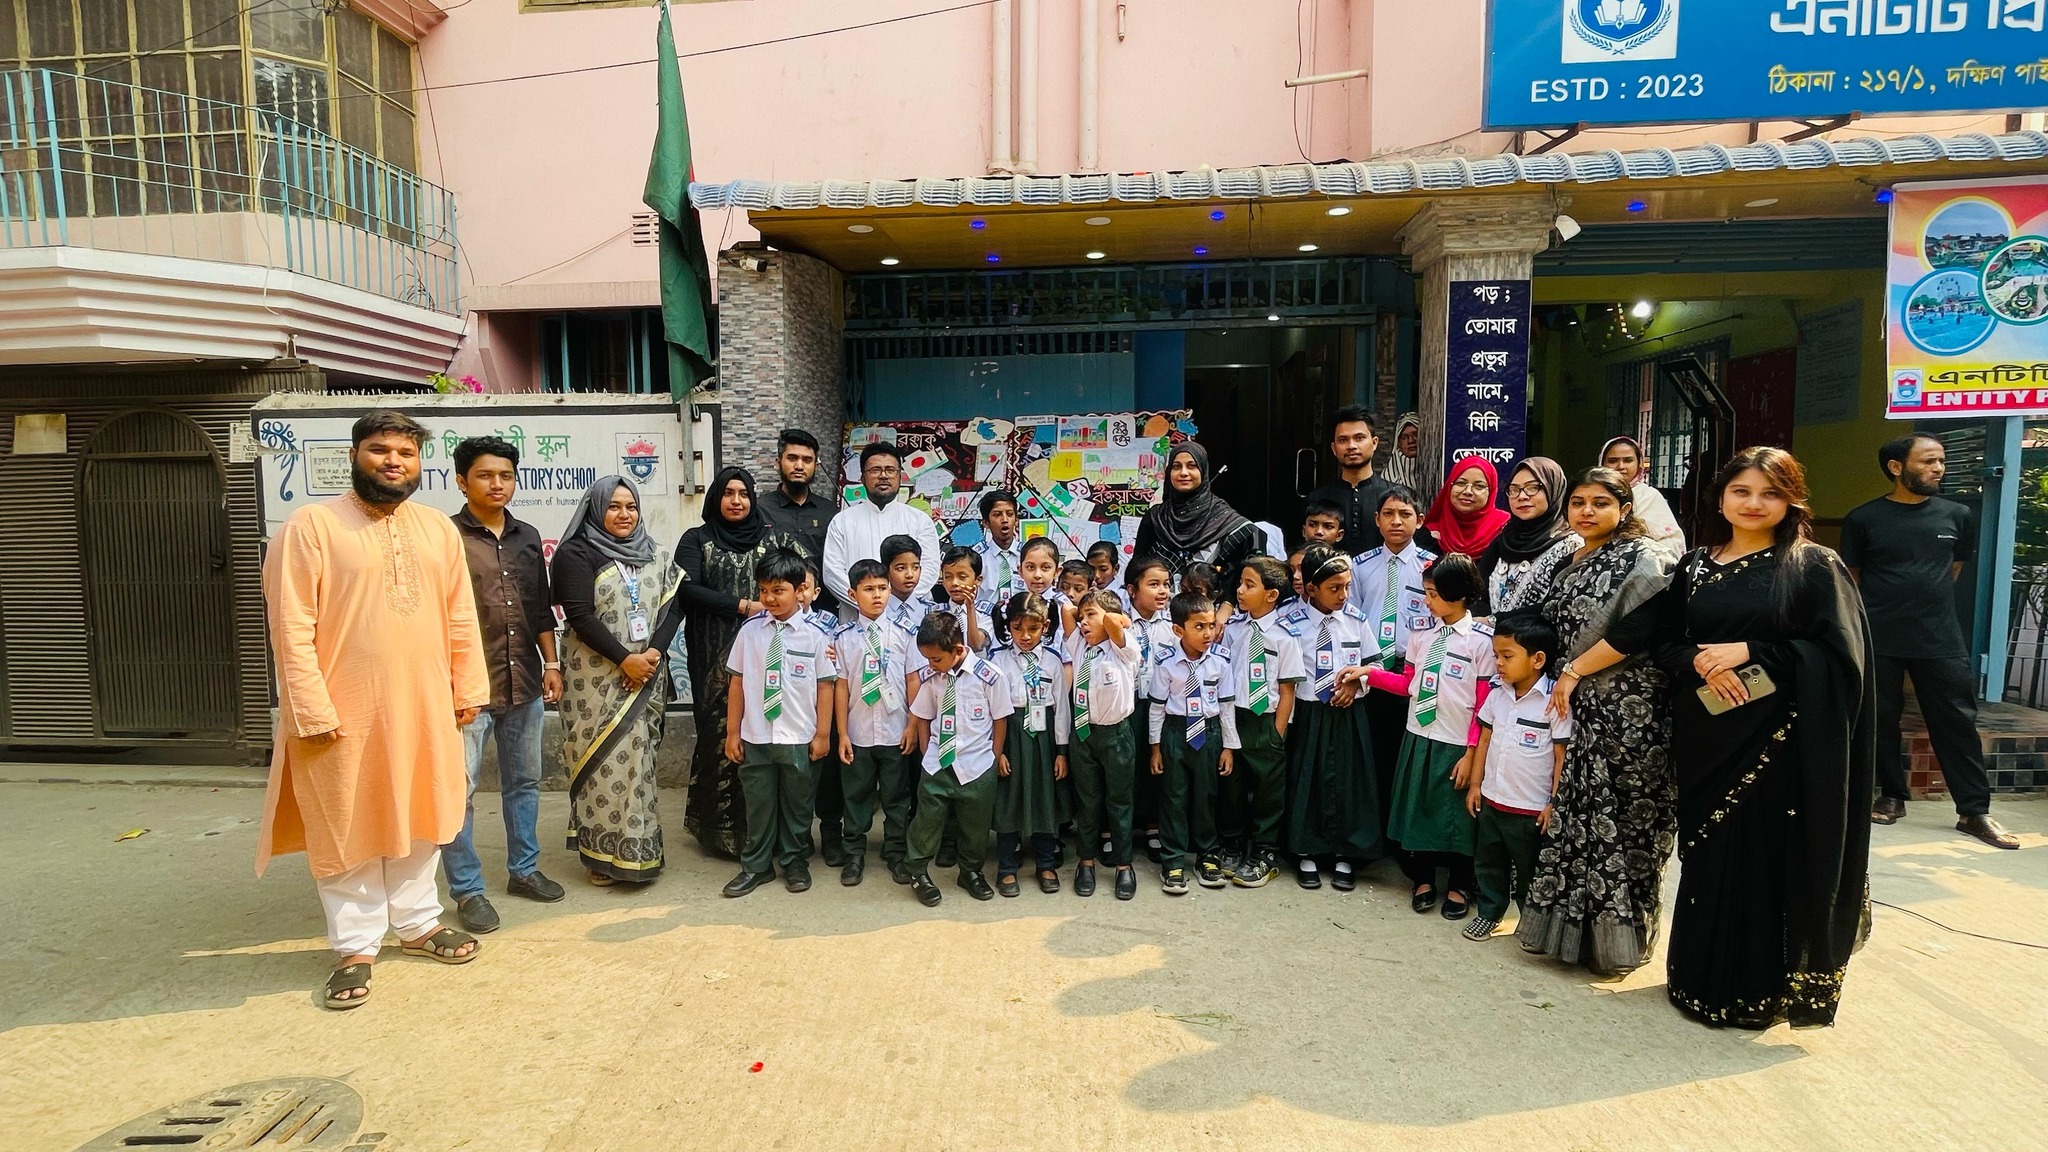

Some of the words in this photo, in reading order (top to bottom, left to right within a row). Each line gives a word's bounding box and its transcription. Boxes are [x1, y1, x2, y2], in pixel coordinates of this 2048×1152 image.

[1768, 63, 1836, 94] ঠিকানা
[1946, 58, 2006, 87] দক্ষিণ
[1531, 77, 1609, 102] ESTD
[1620, 82, 1626, 99] :
[1637, 73, 1704, 98] 2023
[1473, 285, 1500, 304] পড়
[1465, 317, 1517, 335] তোমার
[1466, 383, 1509, 403] নামে,
[1927, 389, 2031, 407] ENTITY
[1468, 411, 1500, 432] যিনি
[508, 497, 542, 507] uccession
